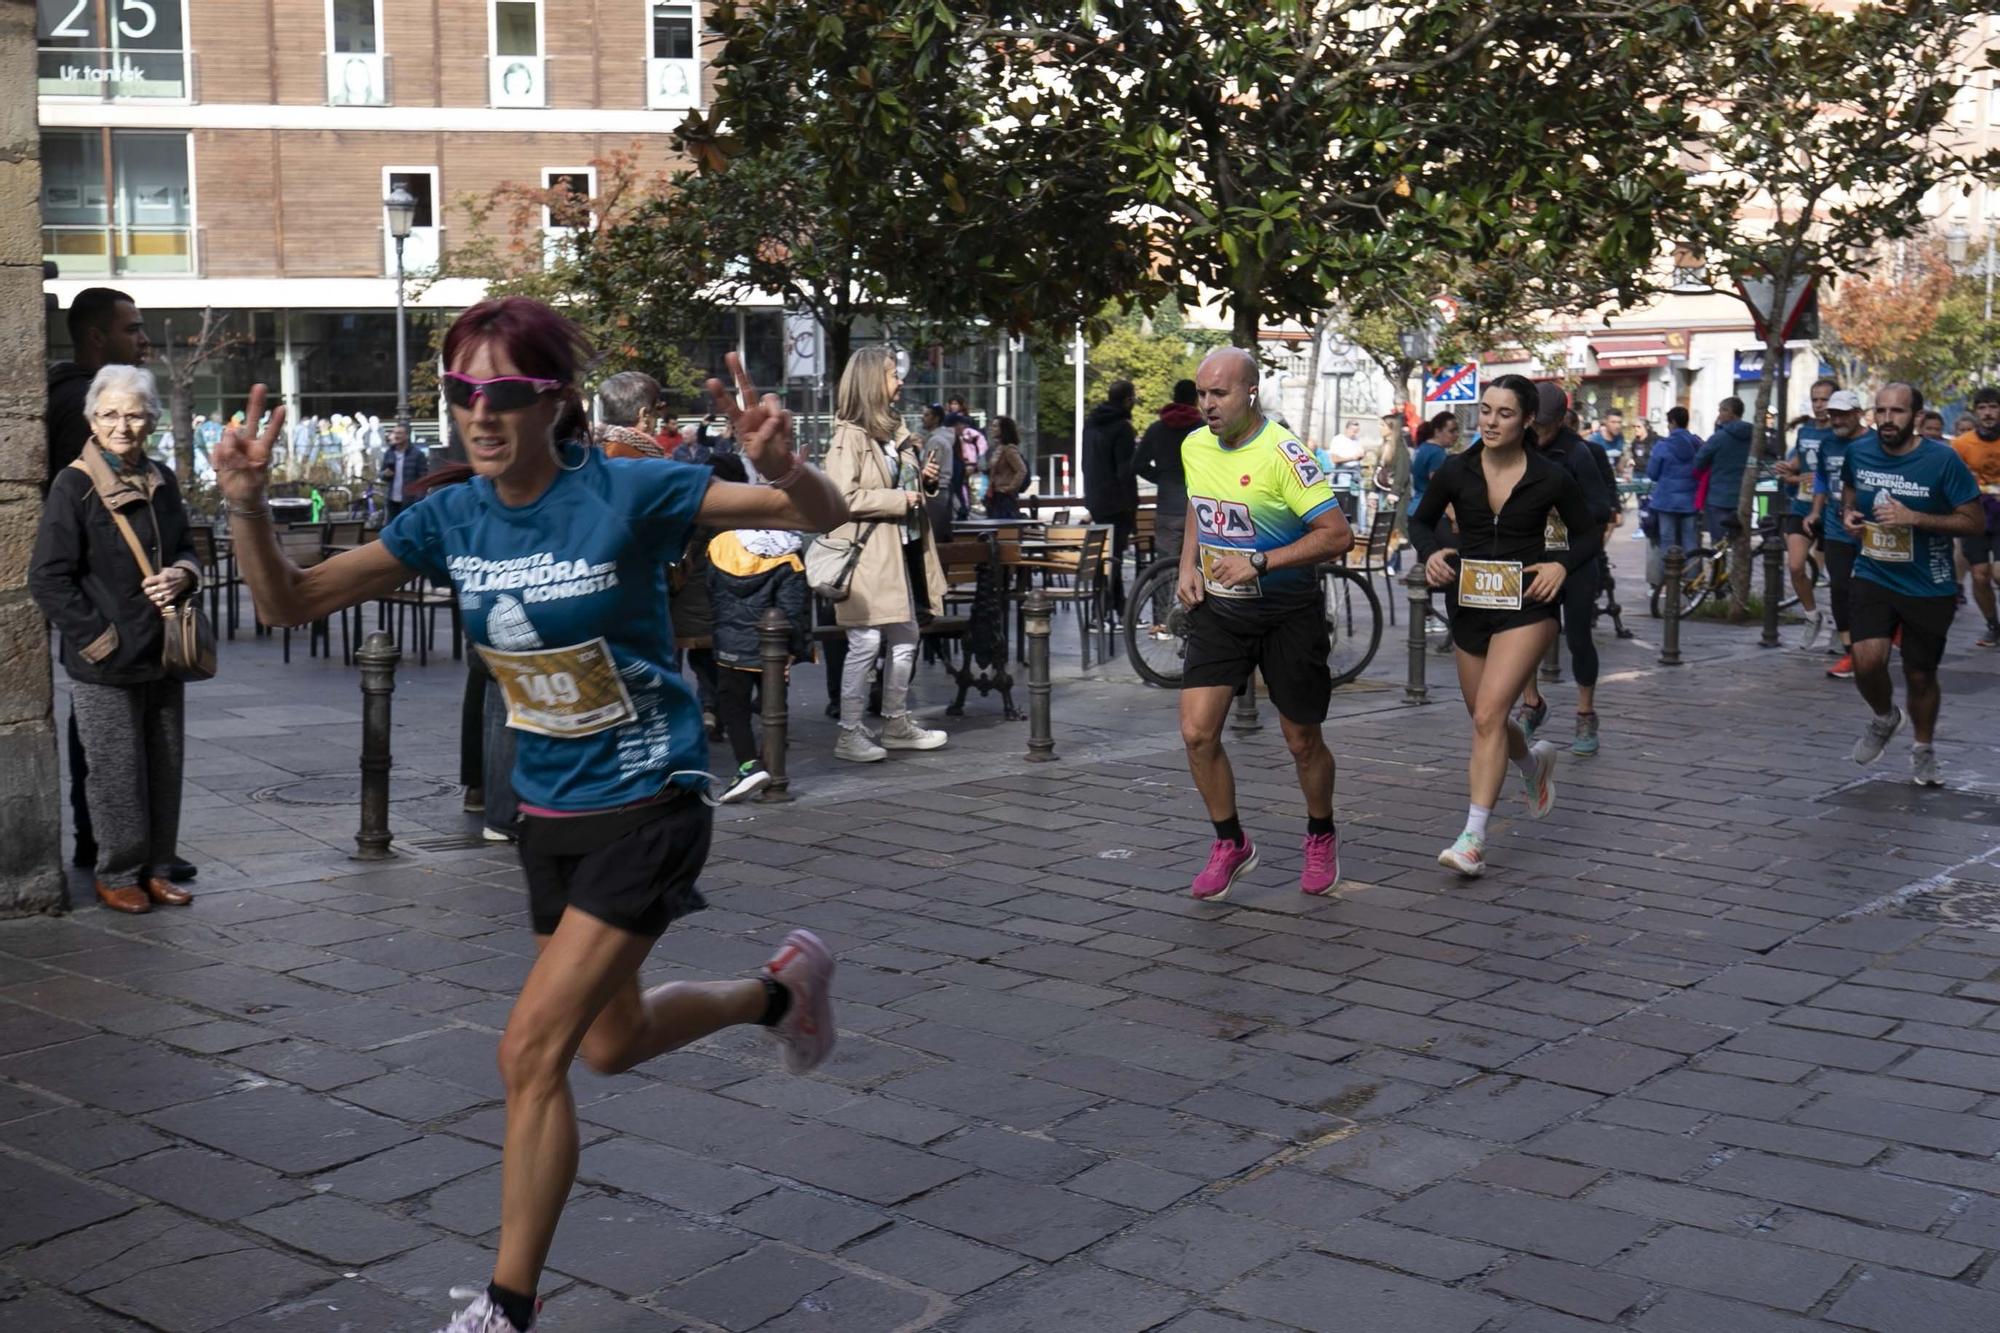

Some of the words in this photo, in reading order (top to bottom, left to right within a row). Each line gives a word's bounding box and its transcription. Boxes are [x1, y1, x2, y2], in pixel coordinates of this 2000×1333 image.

[1864, 477, 1919, 491] ALMENDRA
[461, 557, 591, 593] ALMENDRA
[1475, 572, 1503, 592] 370
[515, 671, 581, 707] 149
